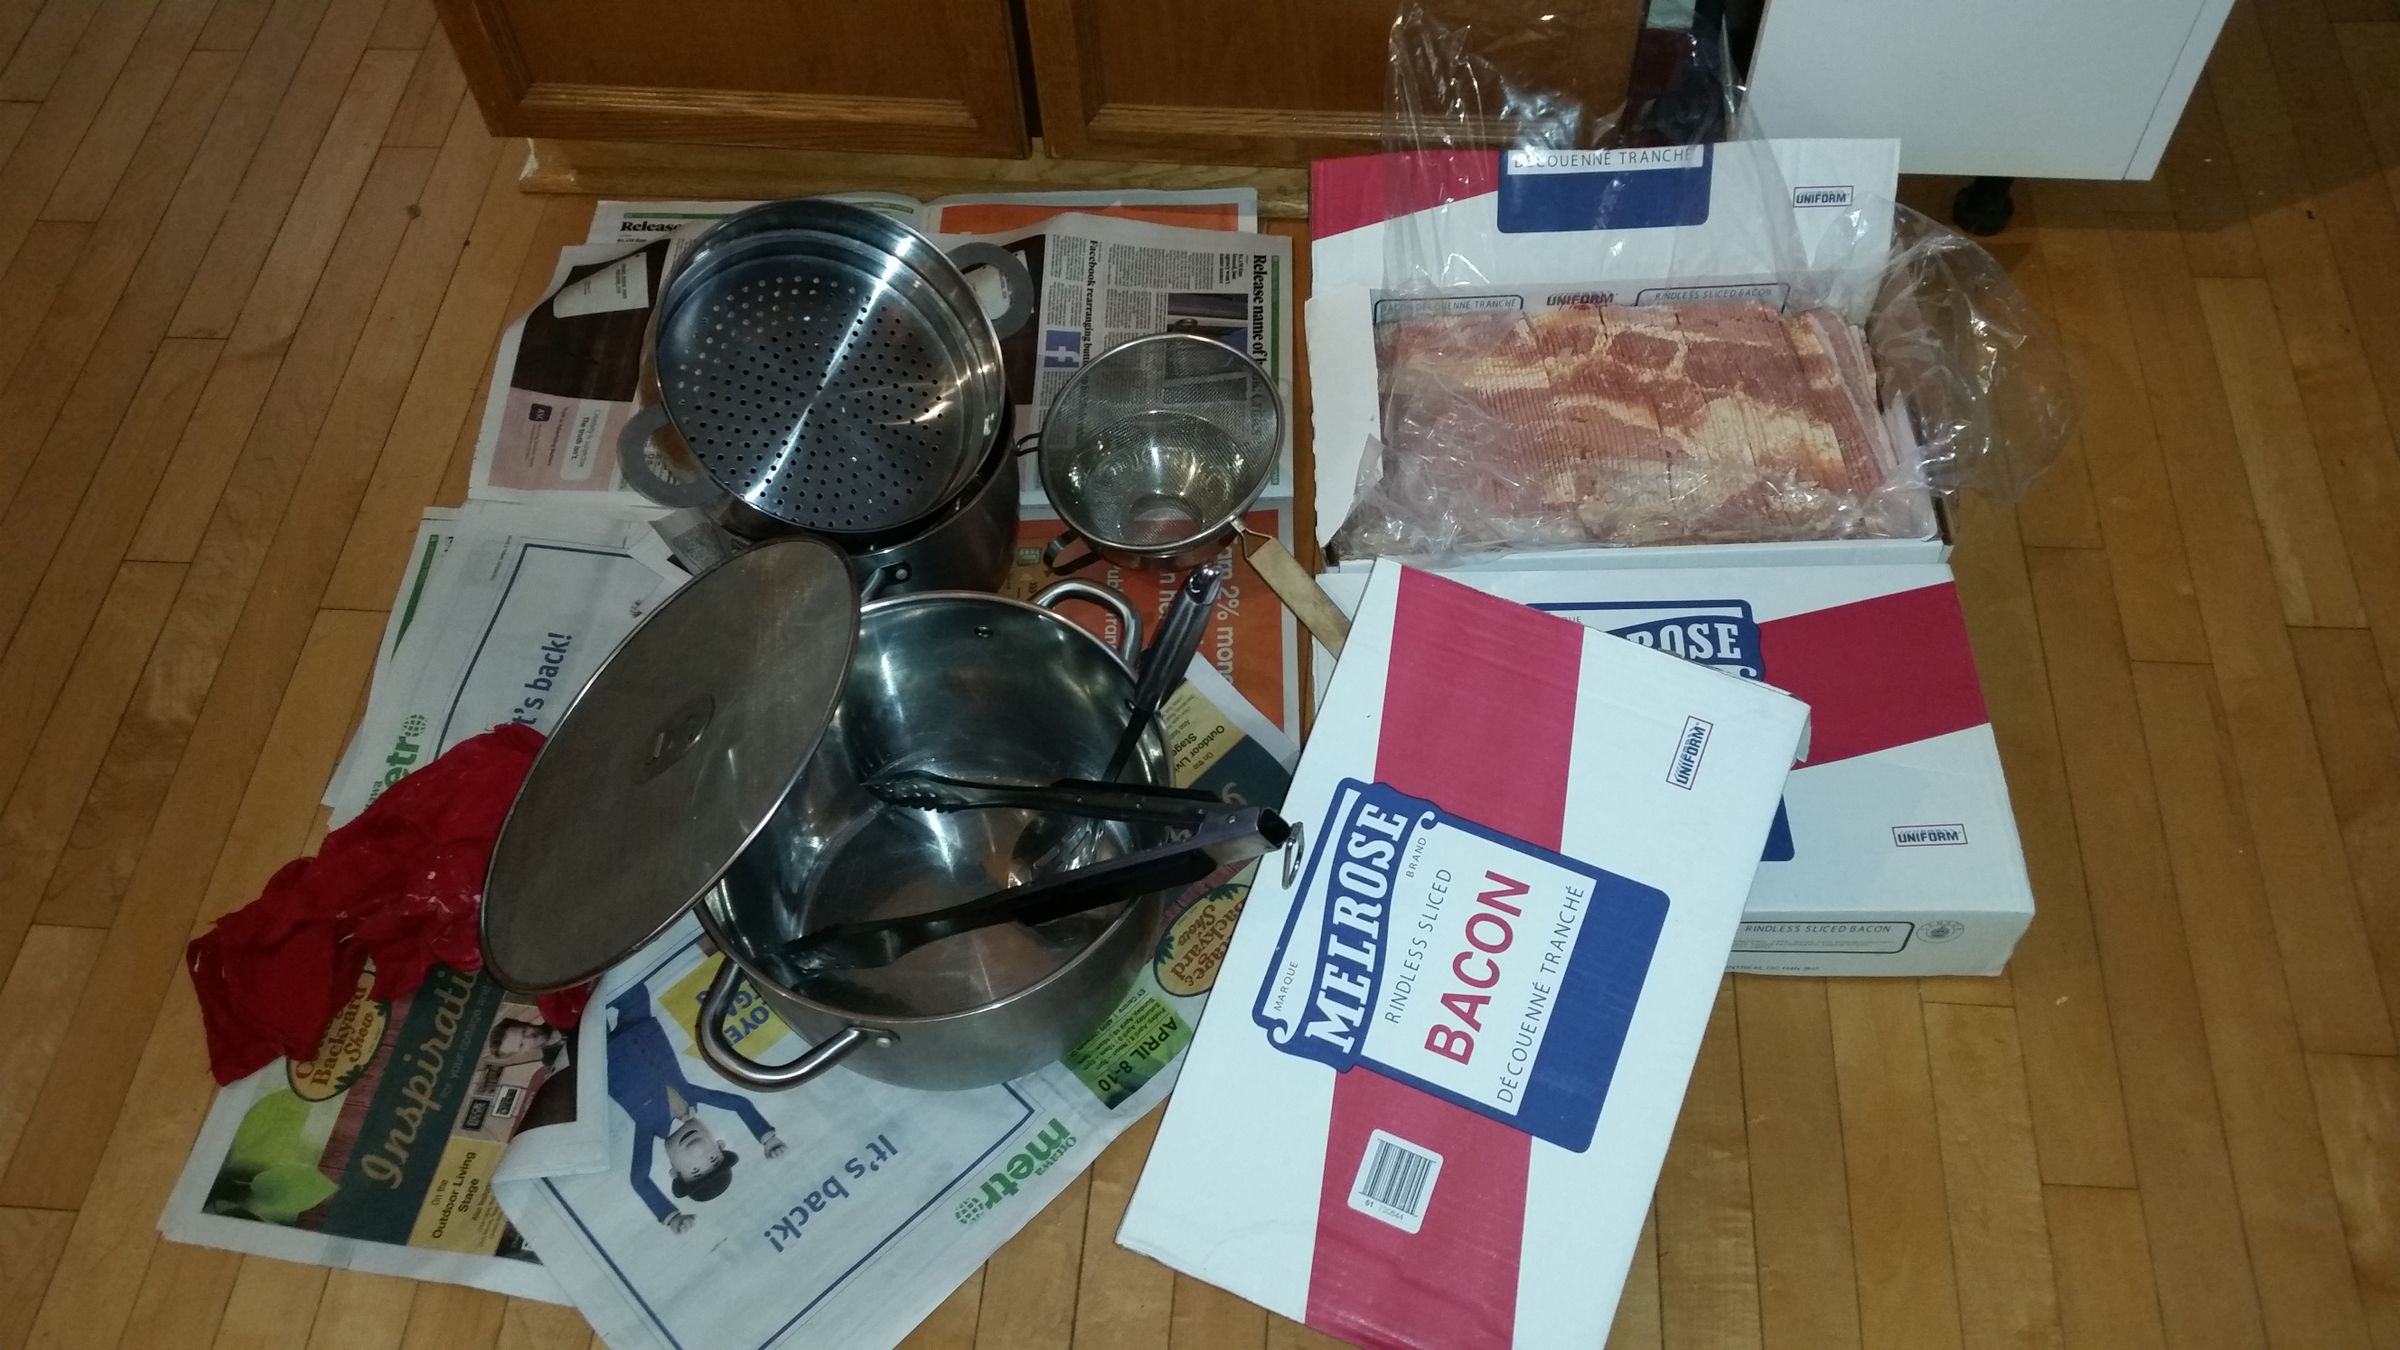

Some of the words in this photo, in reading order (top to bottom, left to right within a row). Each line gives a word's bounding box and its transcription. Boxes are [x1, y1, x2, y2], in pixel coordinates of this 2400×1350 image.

[1796, 191, 1847, 204] UNIFORM
[1087, 240, 1098, 286] Facebook
[1253, 255, 1268, 302] Release
[1082, 287, 1094, 341] rearranging
[1253, 305, 1263, 337] name
[1547, 293, 1614, 307] UNIFORM
[1081, 343, 1092, 367] butto
[1253, 338, 1268, 355] of
[576, 429, 585, 444] truth
[1217, 585, 1240, 621] 2%
[525, 632, 573, 693] back!
[1190, 725, 1225, 757] Outdoor
[1675, 726, 1706, 785] UNIFORM
[1405, 837, 1427, 878] BRAND
[1898, 829, 1959, 843] UNIFORM
[1177, 904, 1216, 946] Show
[1305, 803, 1408, 1054] MELROSE
[1385, 936, 1428, 1024] RINDLESS
[1418, 868, 1452, 933] SLICED
[1745, 924, 1801, 933] RINDLESS
[1804, 924, 1848, 933] SLICED
[1849, 924, 1893, 933] BACON
[1274, 960, 1298, 1012] MARQUE
[1424, 870, 1531, 1066] BACON
[1497, 981, 1551, 1104] DÉCOUENNÉ
[1540, 885, 1584, 976] TRANCHÉ
[310, 984, 368, 1087] Backyard
[344, 1010, 376, 1064] Show
[1130, 1017, 1177, 1060] APRIL
[361, 970, 478, 1190] Inspirati
[1097, 1060, 1133, 1092] 8-10
[846, 1133, 899, 1181] It's
[1034, 1135, 1078, 1177] Ottawa
[431, 1188, 463, 1240] Outdoor
[452, 1150, 477, 1188] Living
[457, 1177, 480, 1213] Stage
[764, 1173, 849, 1253] back!
